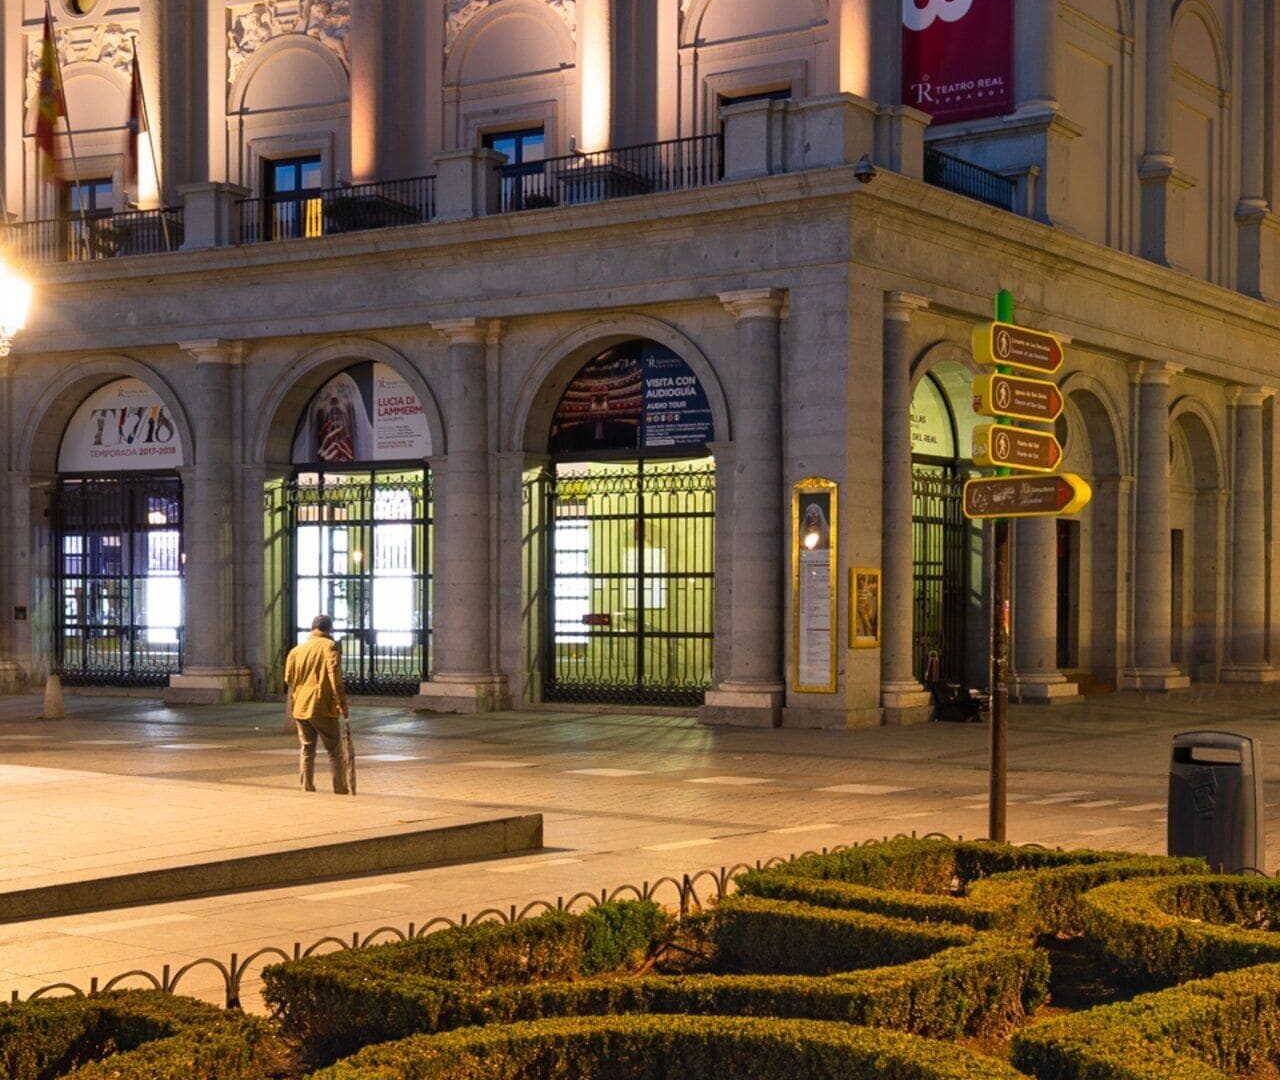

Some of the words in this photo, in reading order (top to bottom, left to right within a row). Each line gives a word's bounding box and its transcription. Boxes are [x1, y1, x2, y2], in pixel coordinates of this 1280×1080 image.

[935, 81, 975, 94] TEATRO
[978, 77, 1005, 87] REAL
[646, 378, 674, 387] VISITA
[676, 377, 696, 385] CON
[646, 386, 697, 398] AUDIOGUÍA
[378, 397, 404, 406] LUCIA
[406, 395, 416, 404] DI
[646, 402, 668, 410] AUDIO
[669, 400, 687, 408] TOUR
[378, 406, 424, 416] LAMMERM
[90, 449, 137, 459] TEMPORADA
[139, 446, 177, 456] 2017-2018
